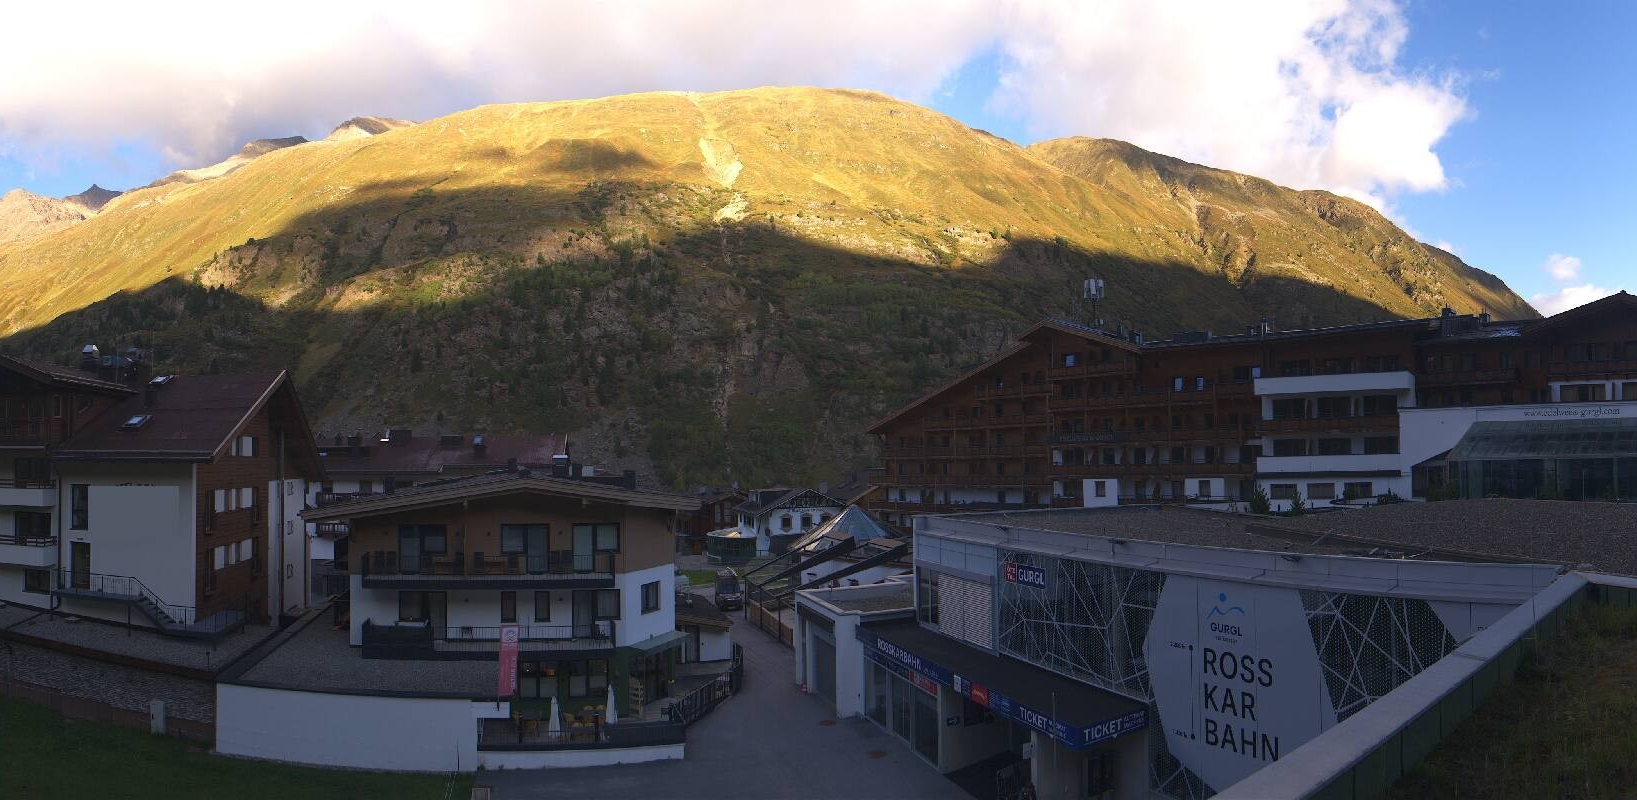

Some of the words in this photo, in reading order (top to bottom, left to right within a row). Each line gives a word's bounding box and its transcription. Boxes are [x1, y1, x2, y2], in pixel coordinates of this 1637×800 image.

[1018, 568, 1045, 585] GURGL
[1210, 622, 1243, 637] GURGL
[877, 638, 921, 670] ROSSKARBAHN
[1203, 647, 1273, 687] ROSS
[1203, 683, 1256, 721] KAR
[1019, 706, 1048, 730] TICKET
[1083, 718, 1122, 742] TICKET
[1205, 718, 1279, 762] BAHN
